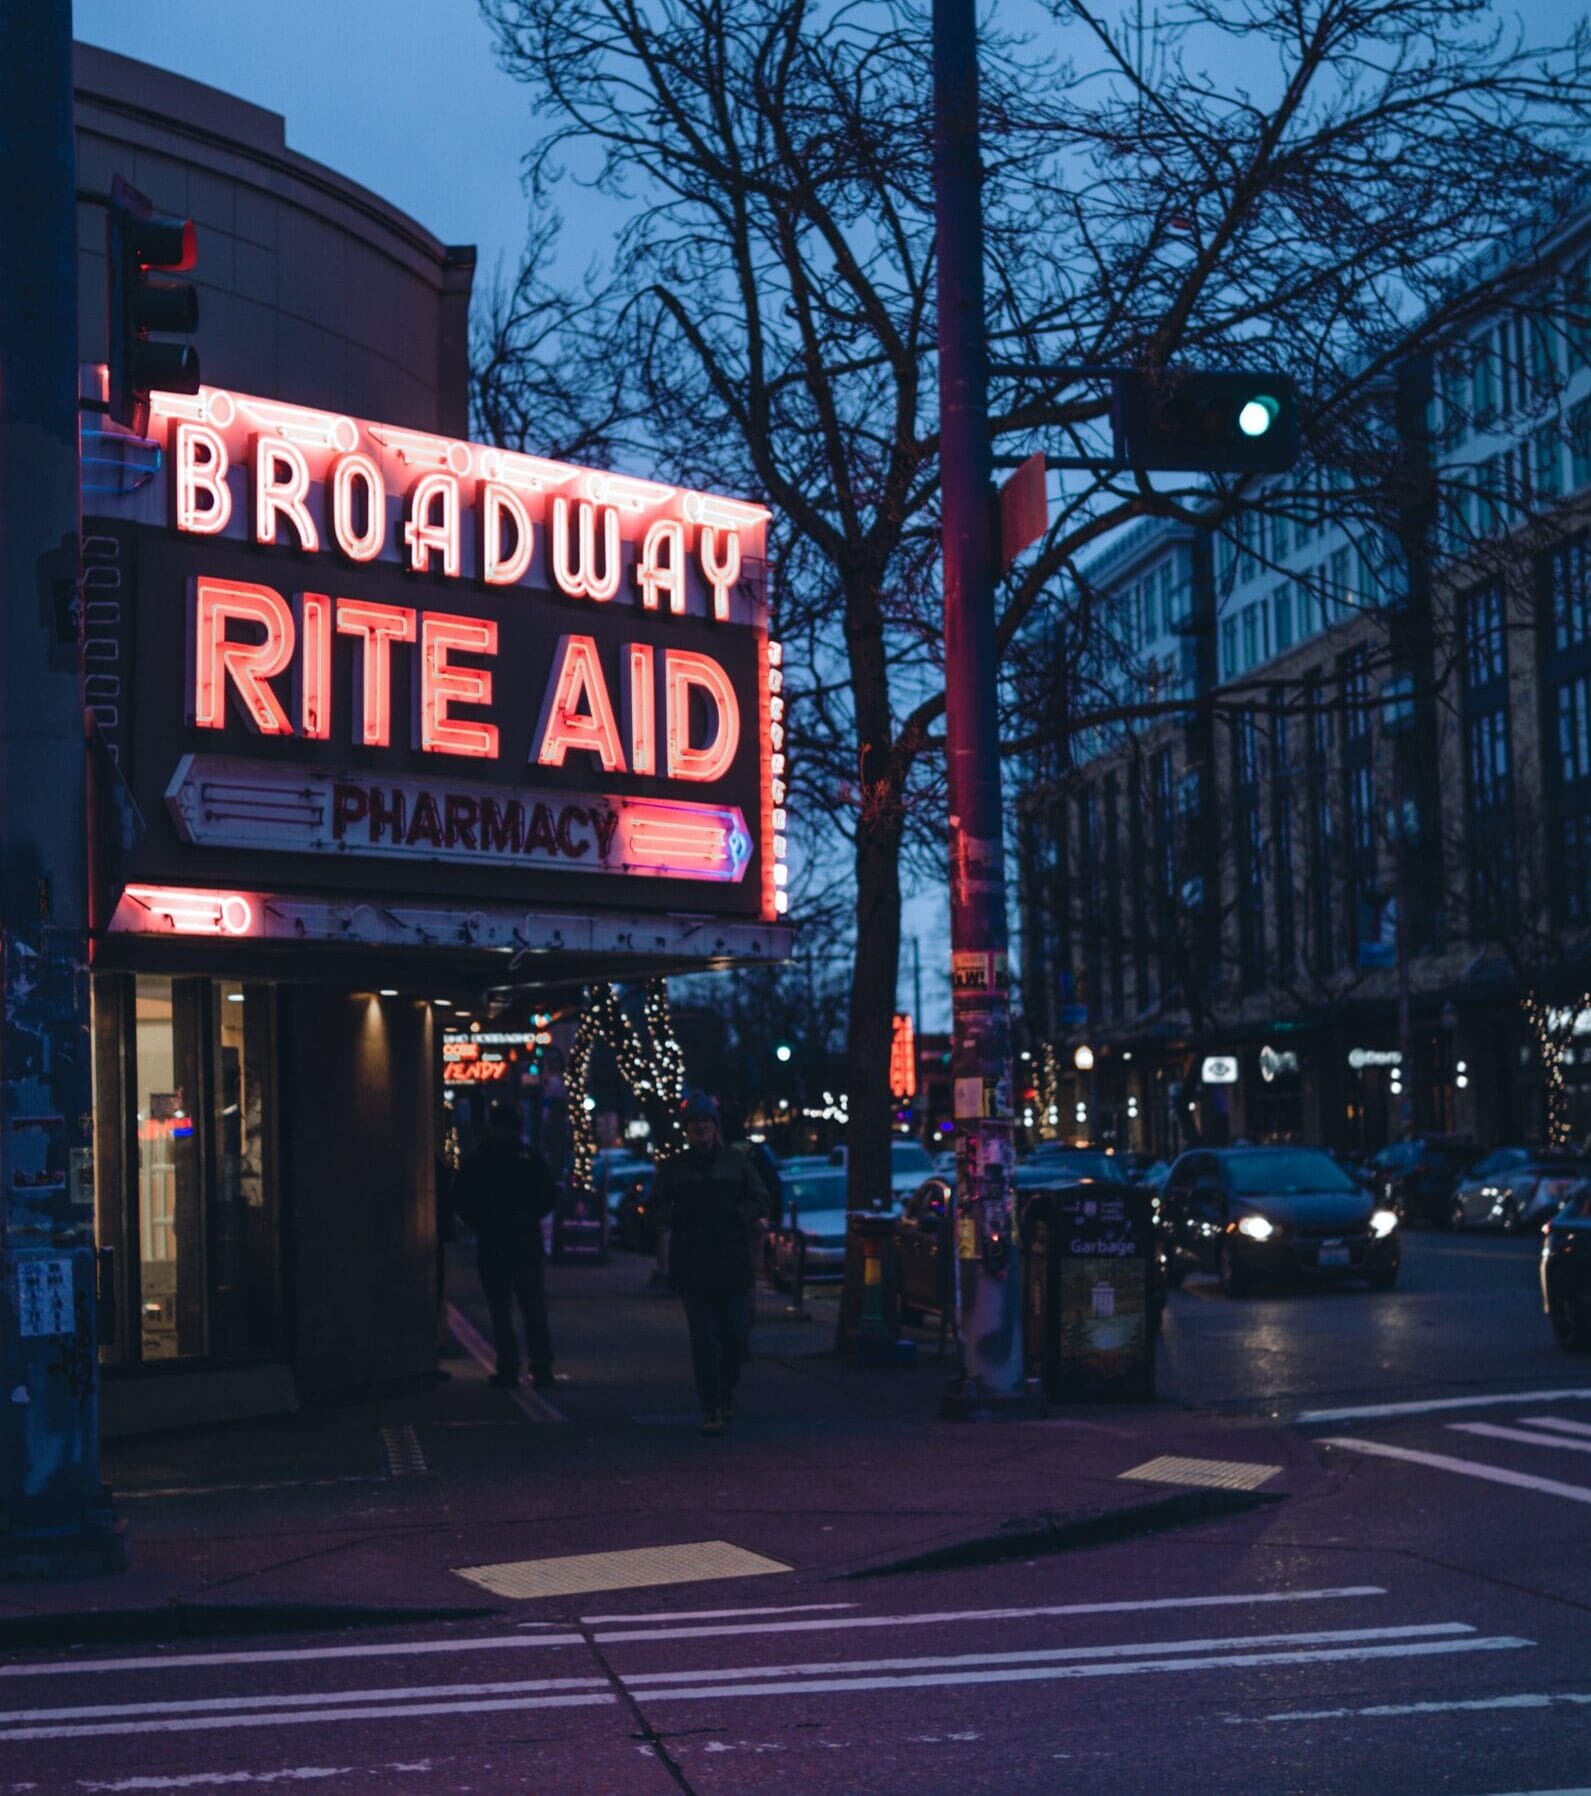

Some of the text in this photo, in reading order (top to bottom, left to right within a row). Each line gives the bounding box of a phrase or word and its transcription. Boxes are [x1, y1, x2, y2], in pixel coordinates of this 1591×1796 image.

[177, 422, 743, 621] BROADWAY
[190, 576, 742, 783] RITE AID
[334, 782, 619, 860] PHARMACY
[1071, 1239, 1136, 1256] Garbage
